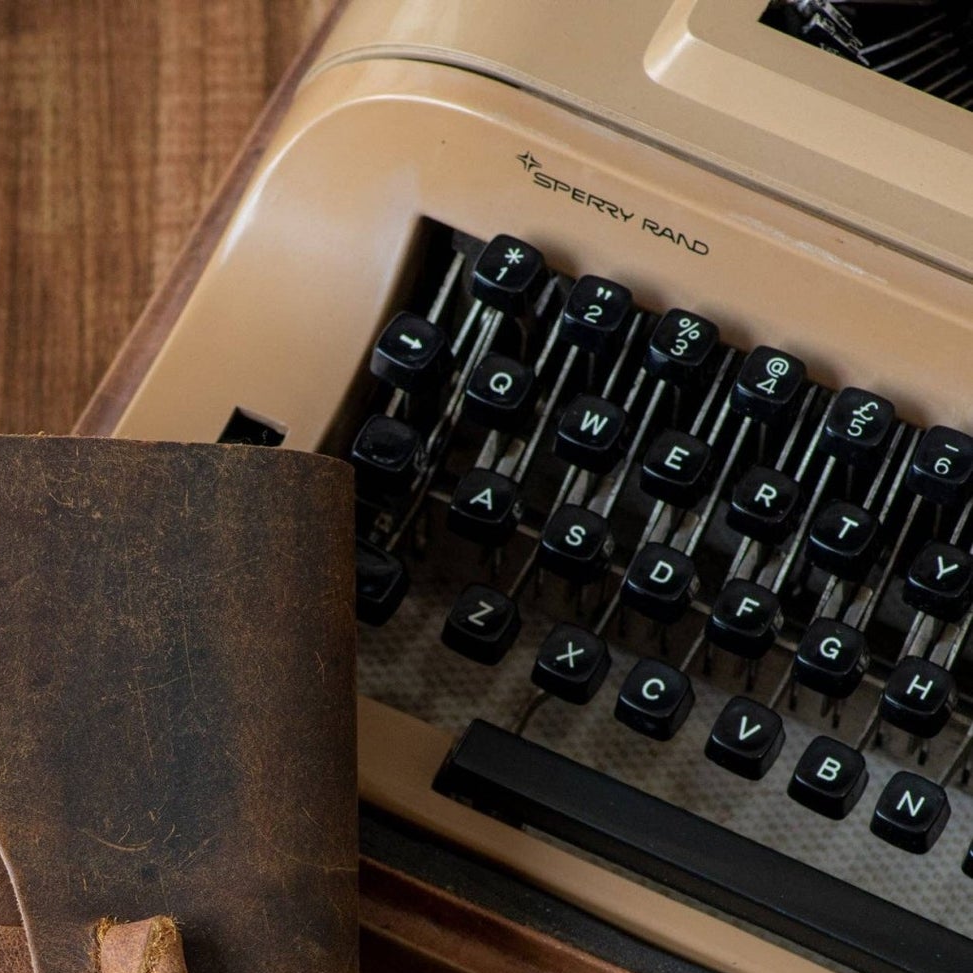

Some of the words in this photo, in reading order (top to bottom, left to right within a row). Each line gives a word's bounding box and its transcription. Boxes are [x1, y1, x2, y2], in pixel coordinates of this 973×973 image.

[531, 170, 635, 223] SPERRY
[640, 216, 710, 256] RAND
[495, 267, 508, 281] 1
[584, 304, 604, 323] 2
[678, 317, 701, 342] %
[671, 339, 689, 357] 3
[766, 356, 790, 379] @
[489, 372, 513, 396] Q
[756, 377, 777, 397] 4
[852, 400, 880, 422] £
[580, 411, 609, 436] W
[846, 419, 865, 438] 5
[664, 446, 690, 471] E
[933, 456, 953, 475] 6
[470, 487, 494, 511] A
[754, 483, 777, 508] R
[564, 524, 586, 547] S
[836, 516, 859, 540] T
[649, 561, 674, 584] D
[935, 555, 960, 580] Y
[468, 602, 494, 627] Z
[735, 597, 760, 618] F
[556, 642, 584, 668] X
[819, 636, 842, 661] G
[641, 679, 666, 701] C
[905, 674, 934, 701] H
[738, 717, 762, 742] V
[816, 757, 842, 783] B
[896, 790, 925, 818] N
